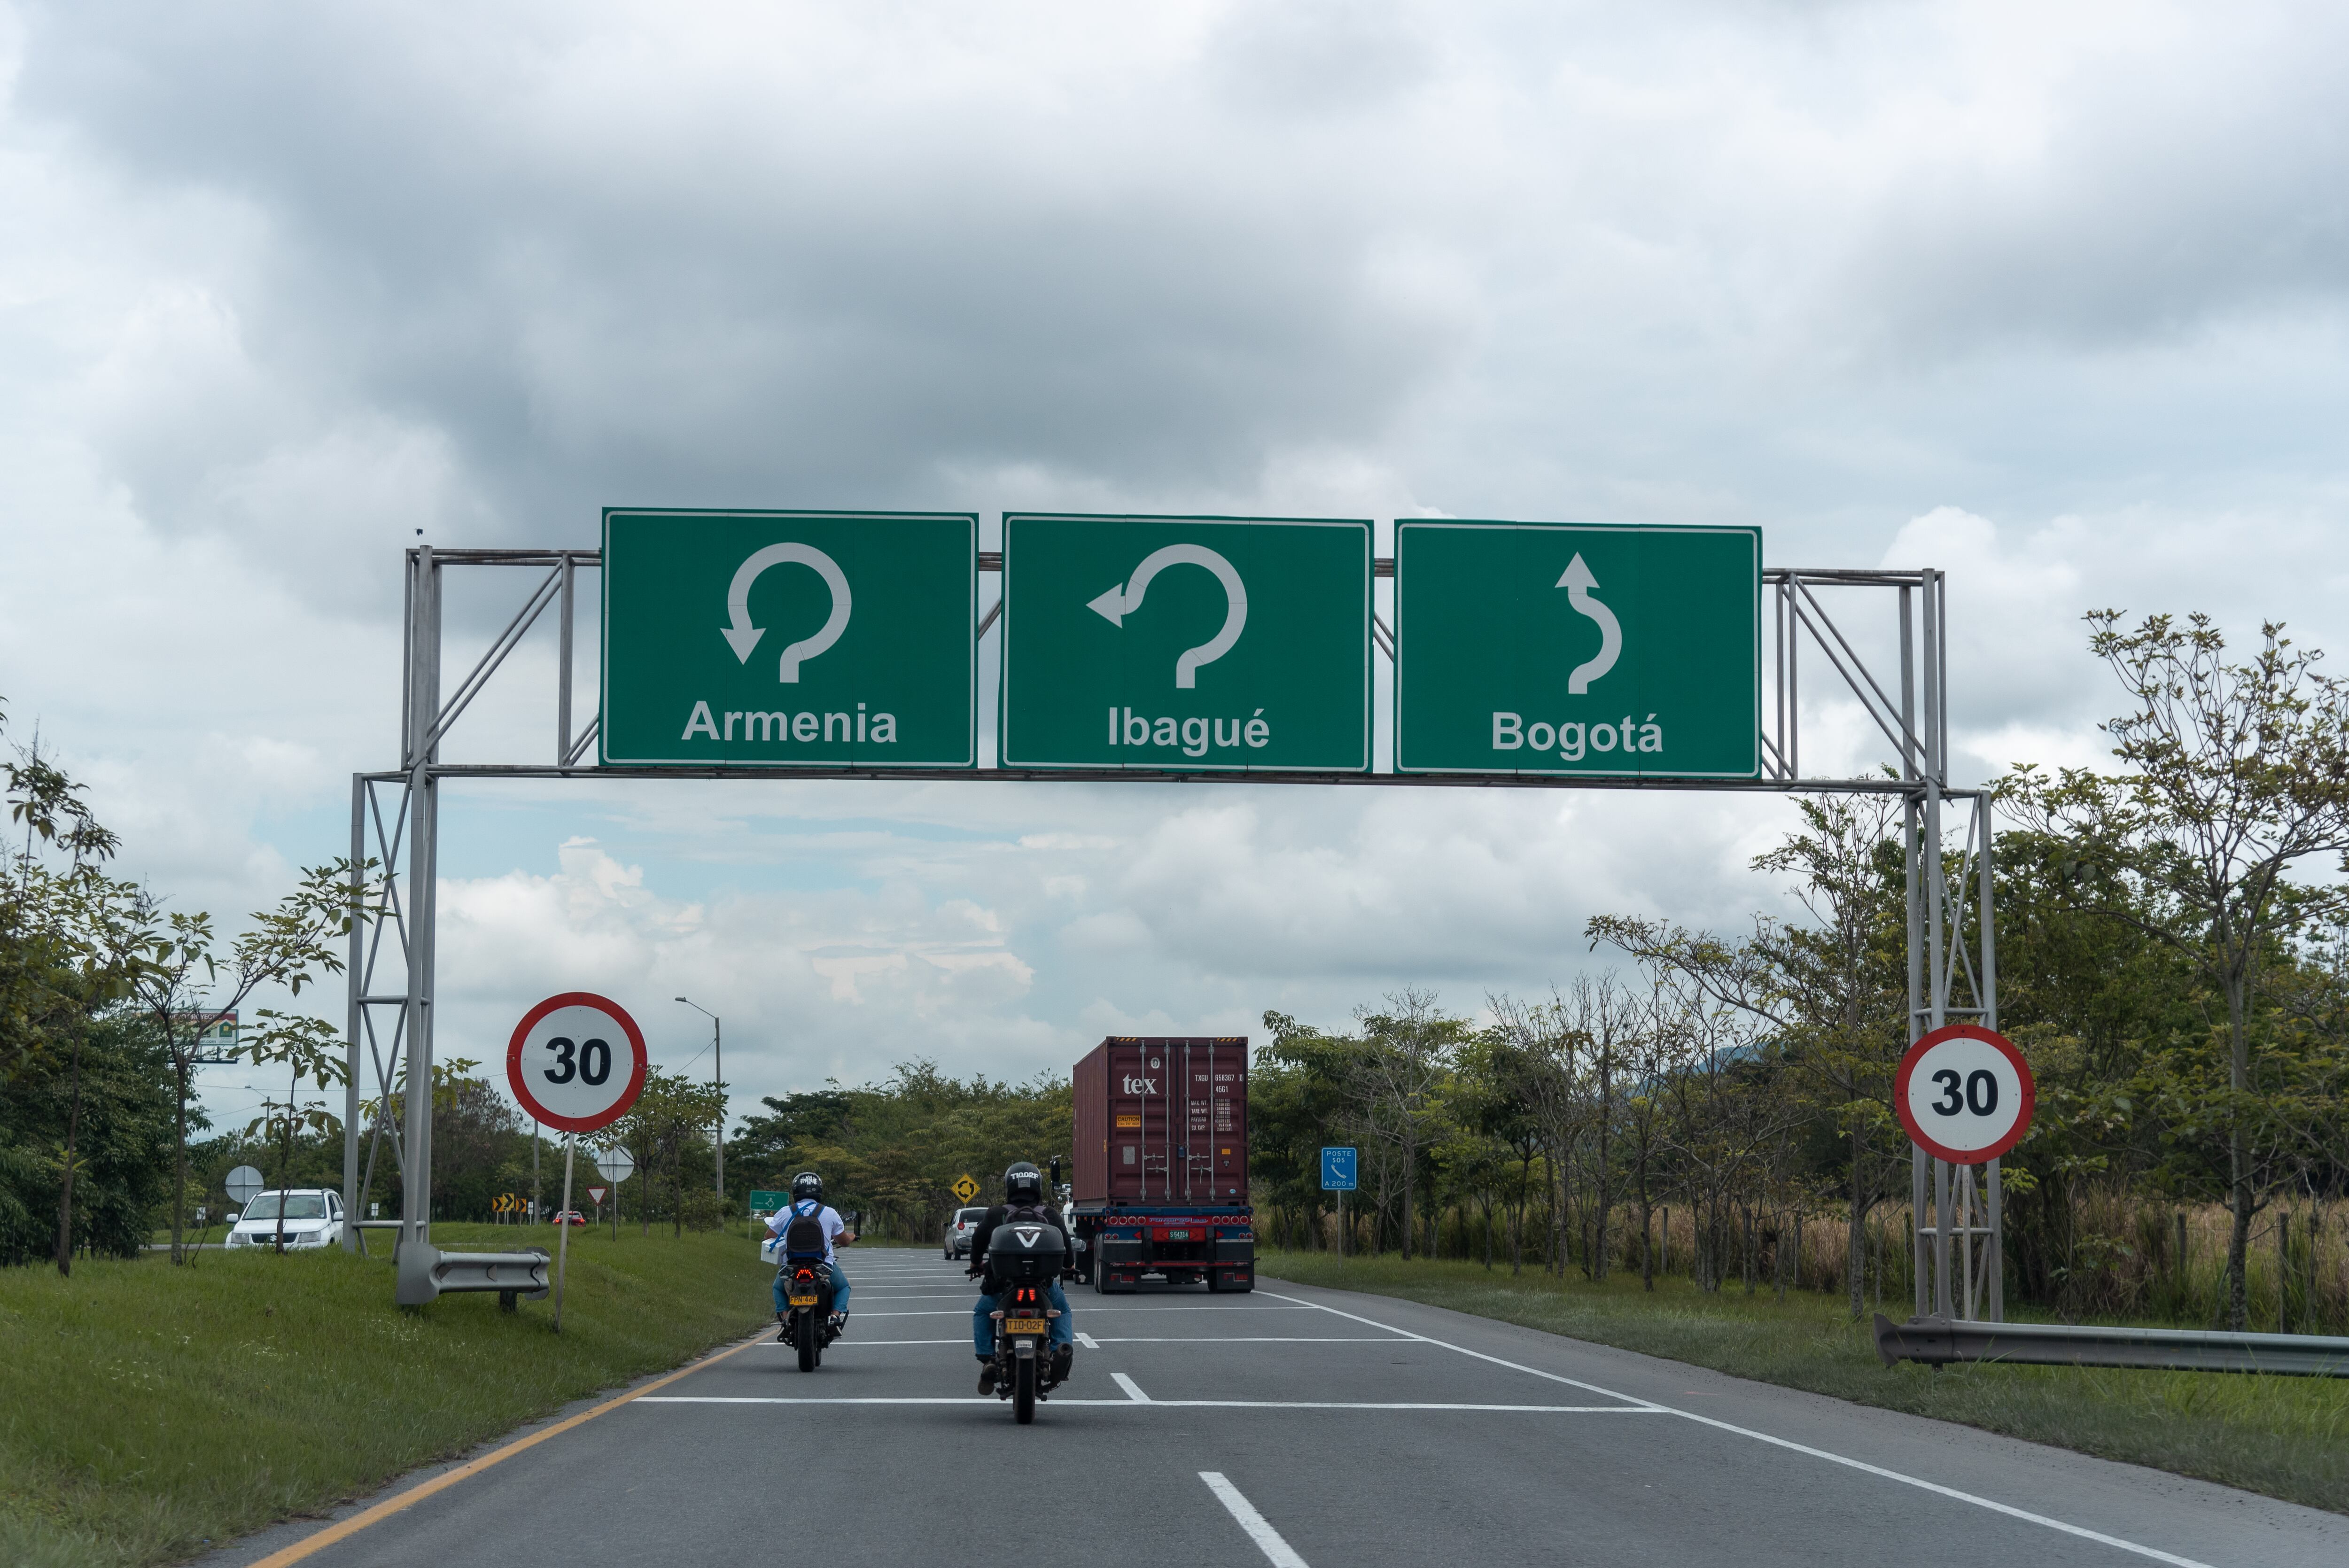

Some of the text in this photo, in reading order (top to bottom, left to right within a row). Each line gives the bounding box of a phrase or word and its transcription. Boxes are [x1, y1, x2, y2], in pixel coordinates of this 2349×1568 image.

[681, 700, 897, 744] Armenia
[1109, 706, 1269, 757] Ibagué
[1493, 712, 1663, 761] Bogotá
[544, 1035, 612, 1086] 30
[1122, 1073, 1157, 1094] tex
[1931, 1069, 1999, 1117] 30
